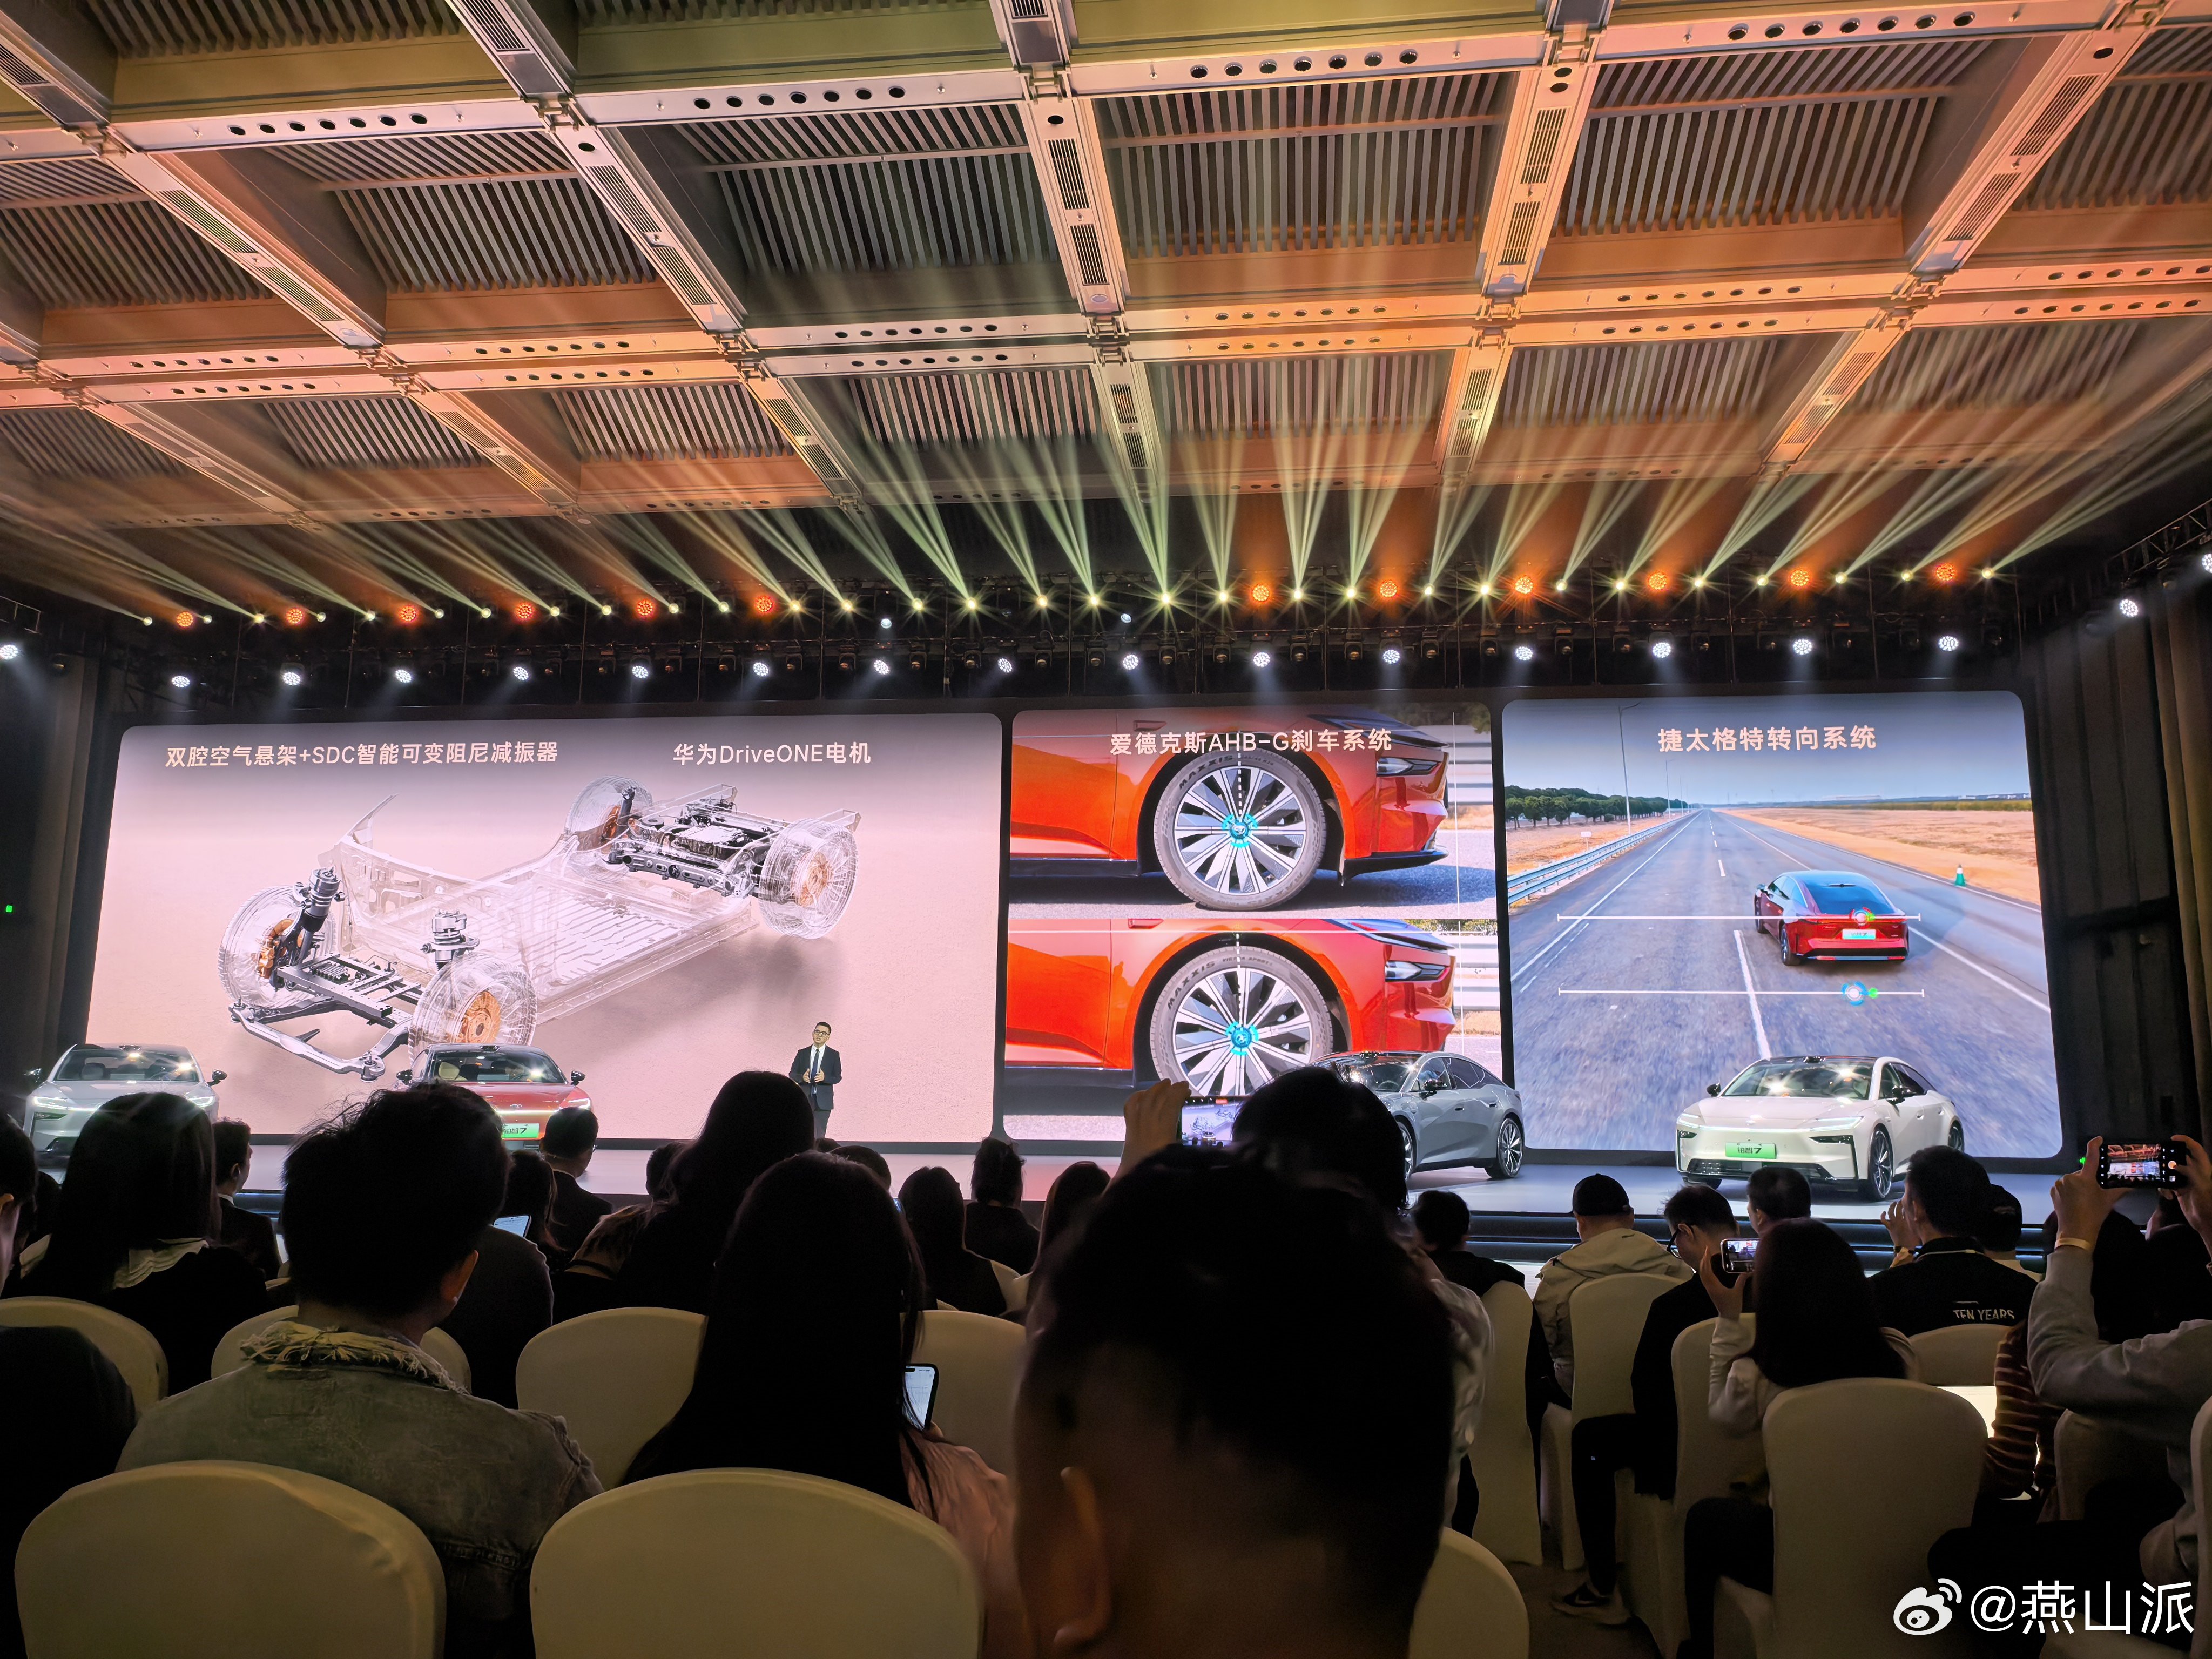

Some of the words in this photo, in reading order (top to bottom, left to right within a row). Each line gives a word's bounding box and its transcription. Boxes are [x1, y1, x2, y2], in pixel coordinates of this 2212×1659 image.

[1110, 728, 1392, 755] 爱德克斯AHB-G刹车系统
[1658, 724, 1877, 753] 捷太格特转向系统
[165, 741, 559, 768] 双腔空气悬架+SDC智能可变阻尼减振器
[672, 741, 872, 765] 华为DriveONE电机
[1178, 755, 1233, 790] MAXXIS
[1167, 961, 1216, 1010] MAXXIS
